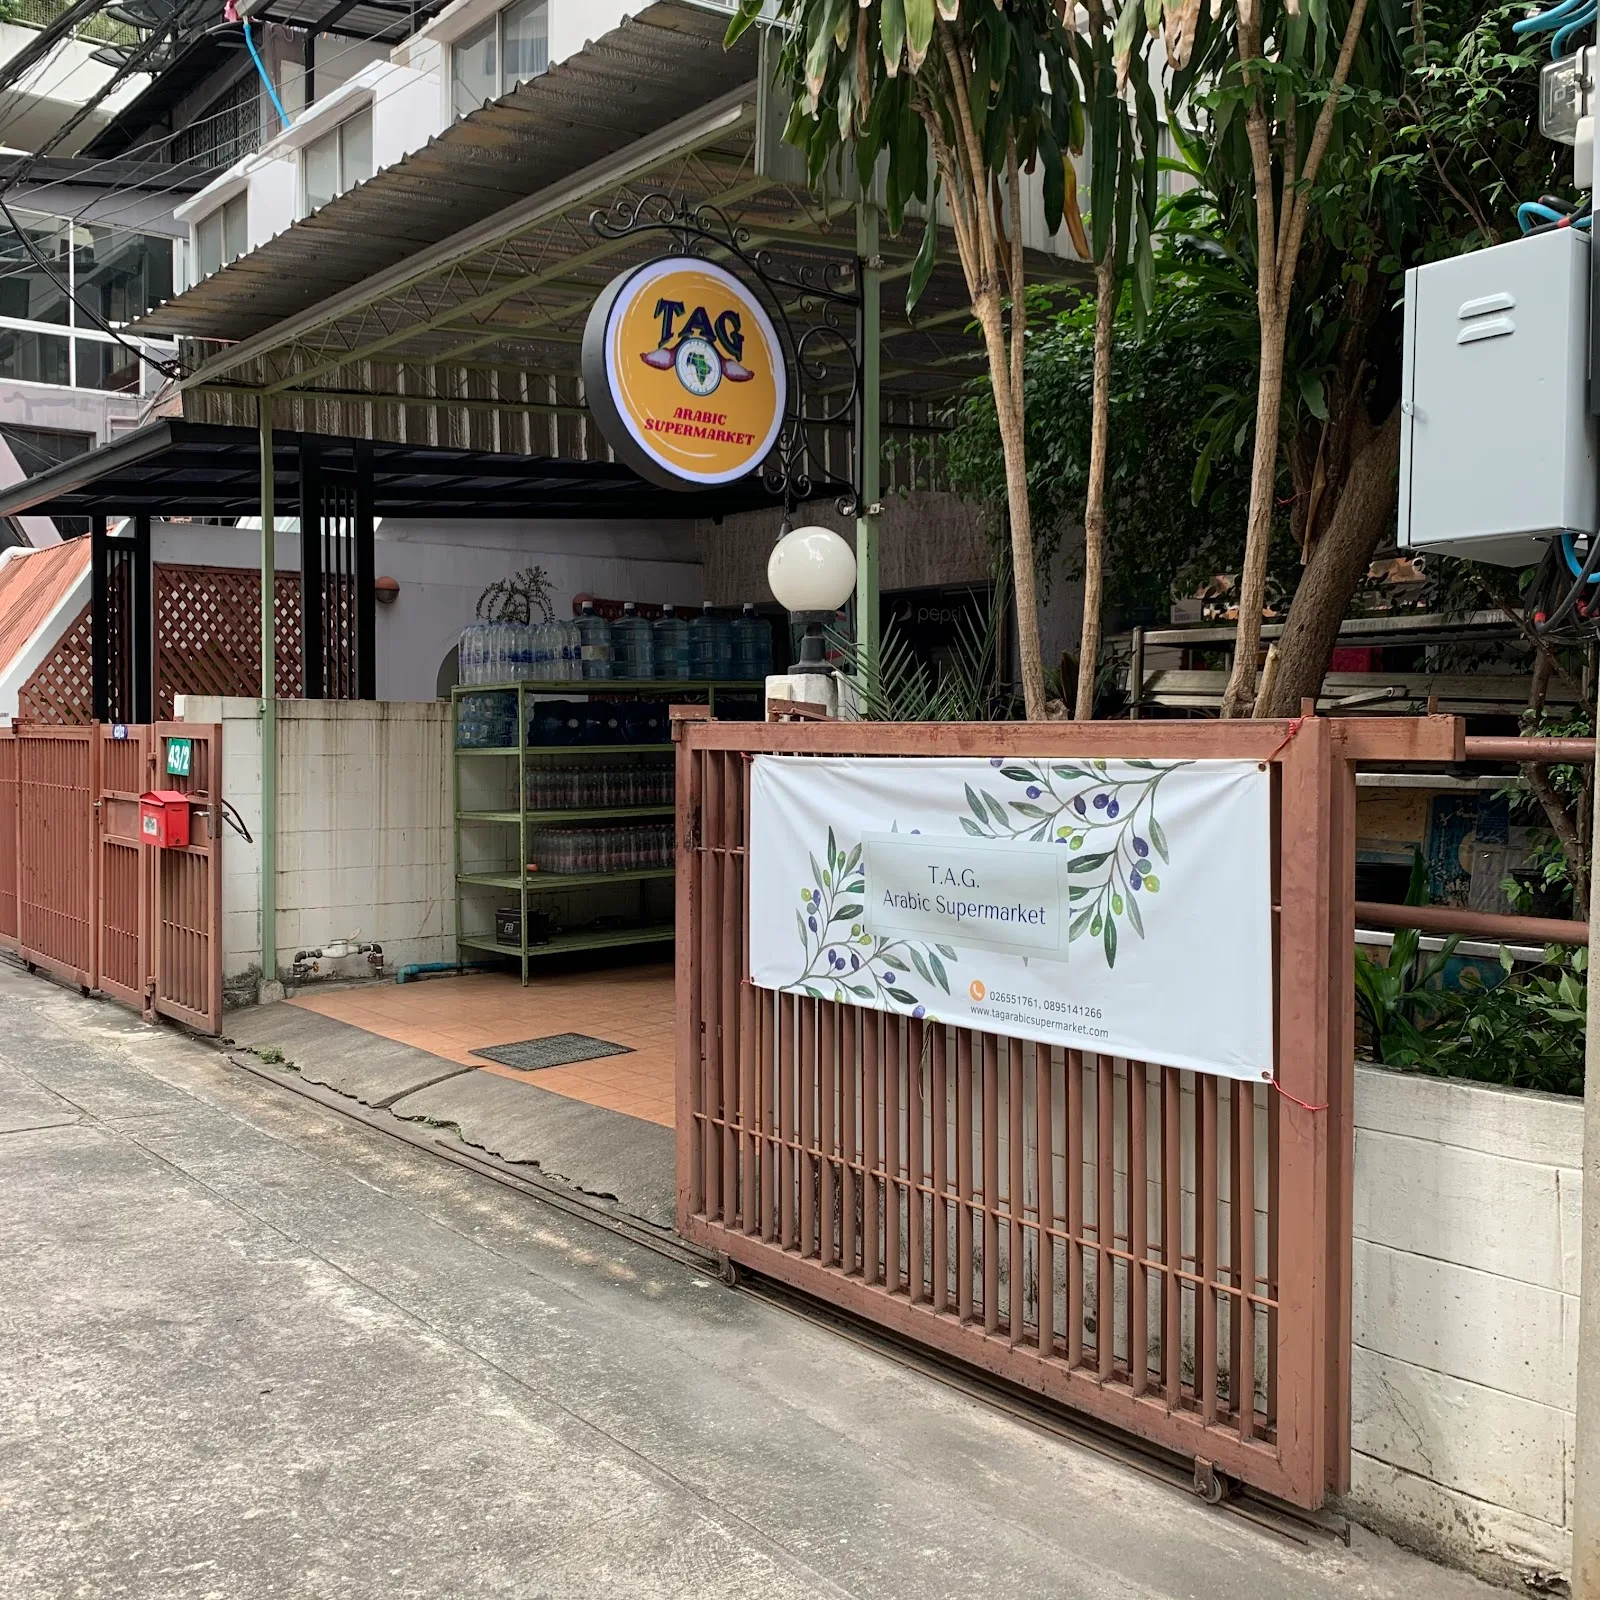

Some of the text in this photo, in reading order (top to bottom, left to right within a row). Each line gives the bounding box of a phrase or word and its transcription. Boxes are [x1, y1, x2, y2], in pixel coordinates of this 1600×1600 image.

[653, 298, 745, 361] TAG
[673, 407, 727, 426] ARABIC
[644, 419, 755, 446] SUPERMARKET
[168, 745, 190, 771] 43/2
[928, 865, 980, 888] T.A.G.
[883, 889, 1046, 925] Arabic Supermarket
[989, 991, 1102, 1019] 026551761, 0895141266
[970, 1005, 1109, 1038] www.tagarabicsupermarket.com
